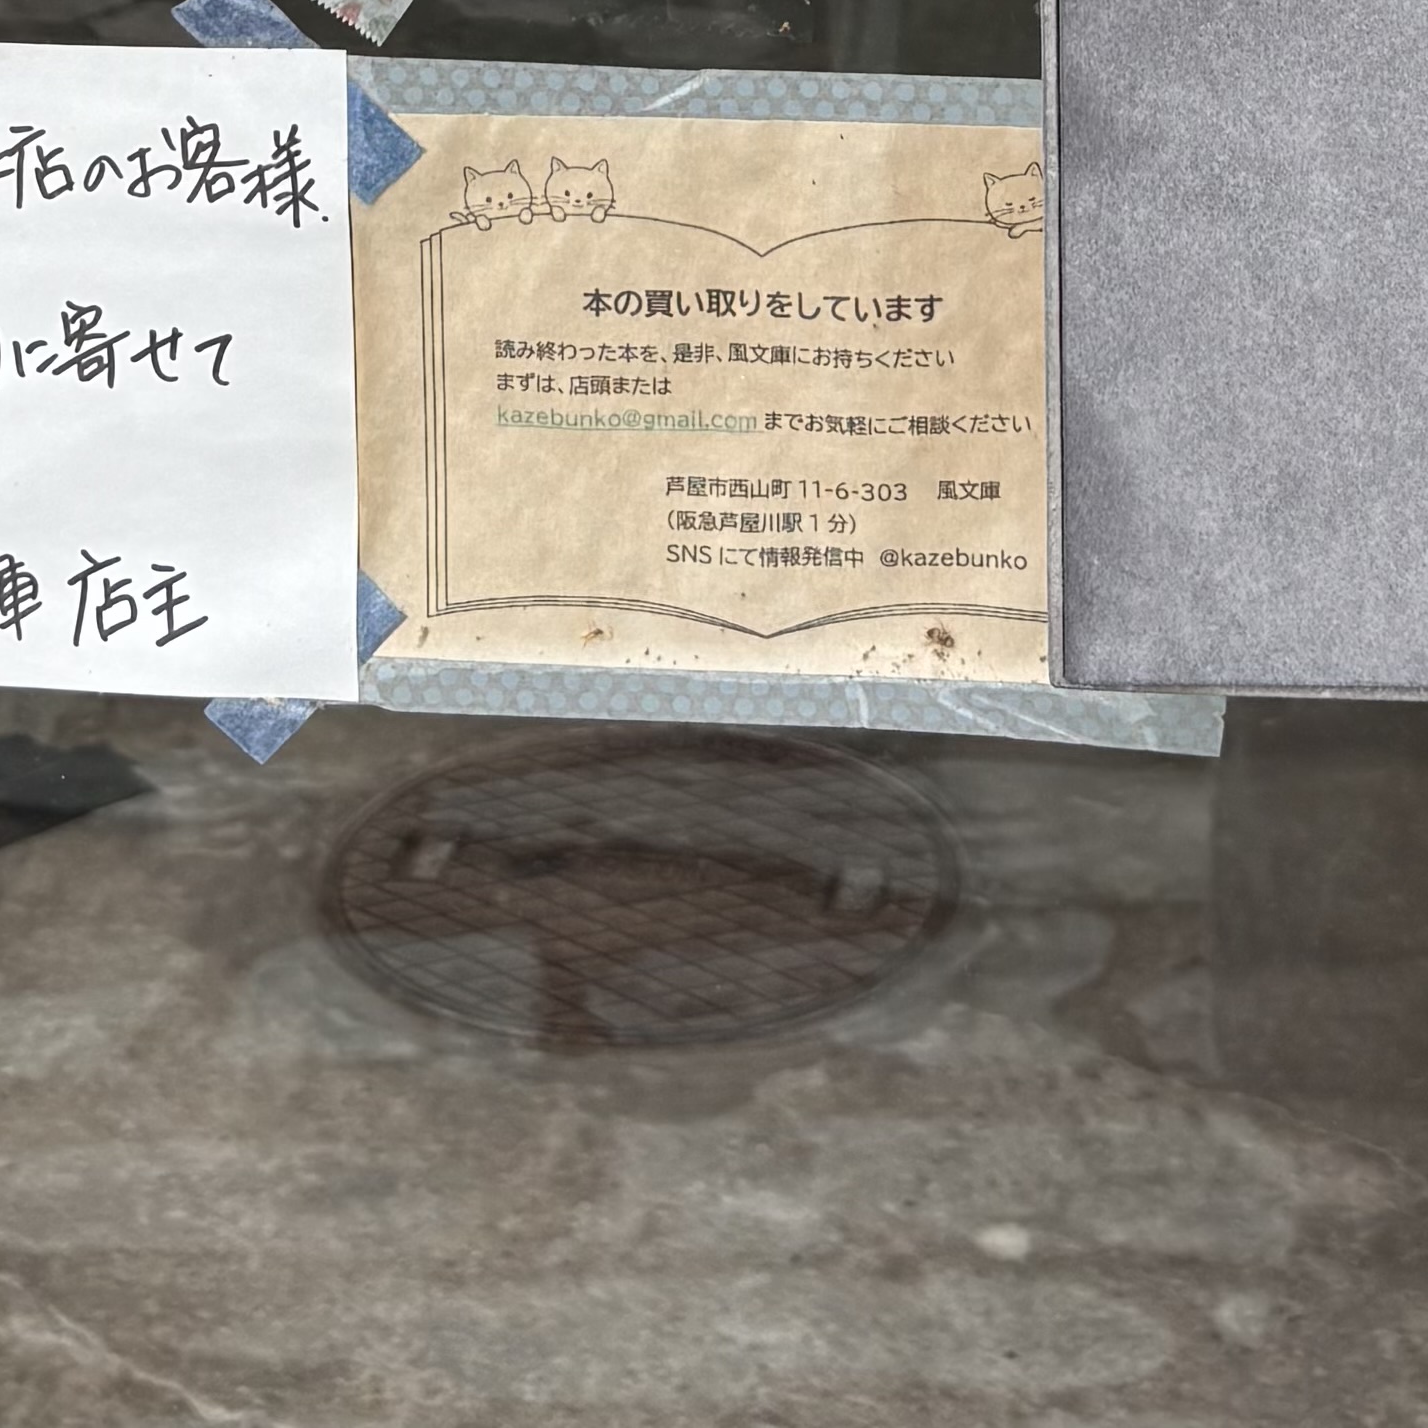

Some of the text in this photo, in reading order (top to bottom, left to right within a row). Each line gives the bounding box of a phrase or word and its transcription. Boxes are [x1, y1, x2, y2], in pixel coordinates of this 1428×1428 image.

[582, 287, 944, 324] 本の買い取りをしています
[495, 372, 673, 398] まずは、店頭または
[496, 404, 1033, 437] kazebunko@gmail.com までお気軽にご相談ください
[936, 479, 1002, 502] 風文庫
[665, 546, 713, 567] SNS
[878, 550, 1029, 573] @kazebunko
[66, 548, 209, 648] 店主
